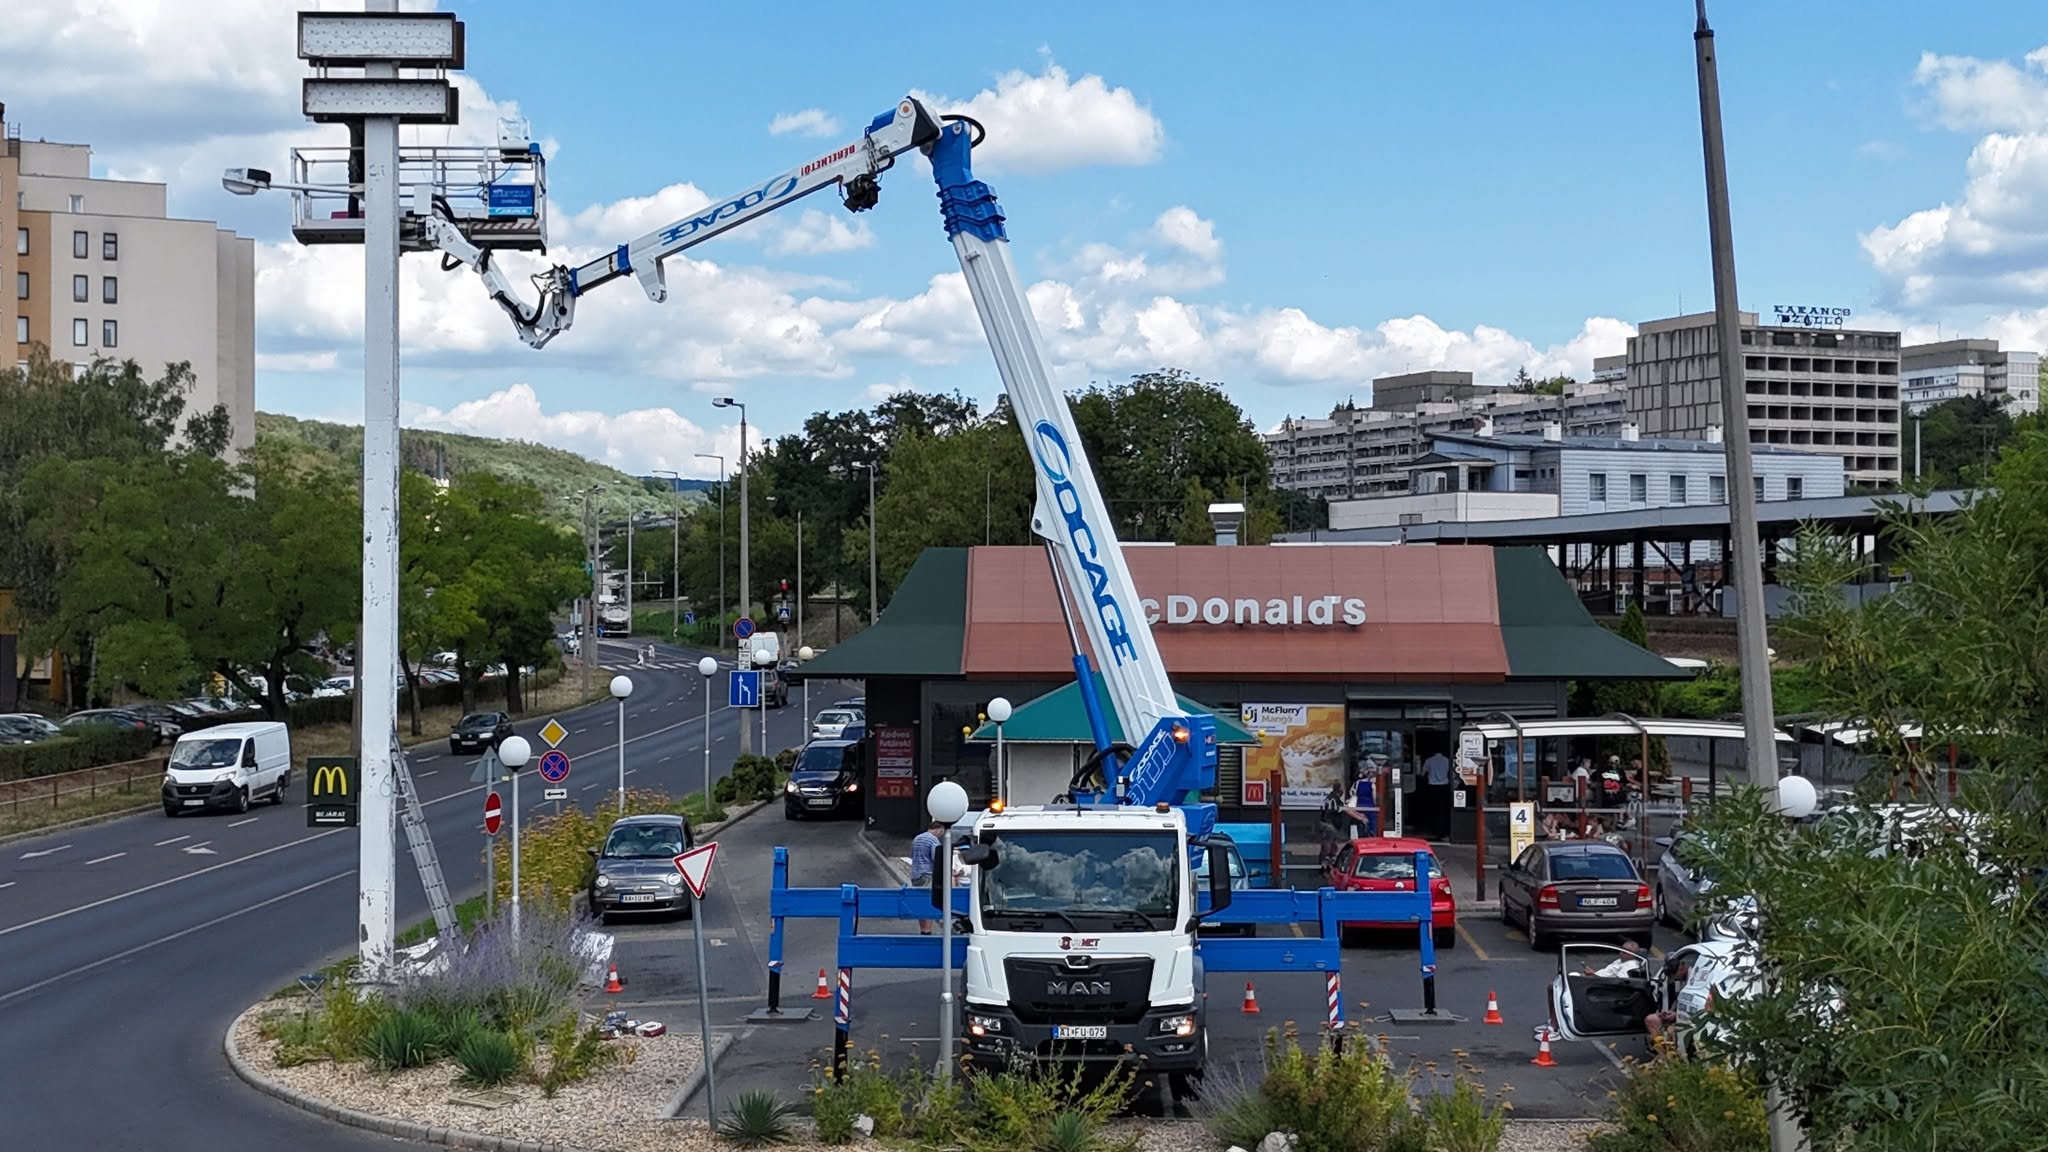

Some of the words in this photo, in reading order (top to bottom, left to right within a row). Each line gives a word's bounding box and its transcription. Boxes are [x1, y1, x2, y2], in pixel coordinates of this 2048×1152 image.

[1141, 595, 1366, 625] cDonald's
[1262, 706, 1302, 716] McFlurry
[1516, 809, 1527, 823] 4
[1048, 982, 1111, 995] MAN
